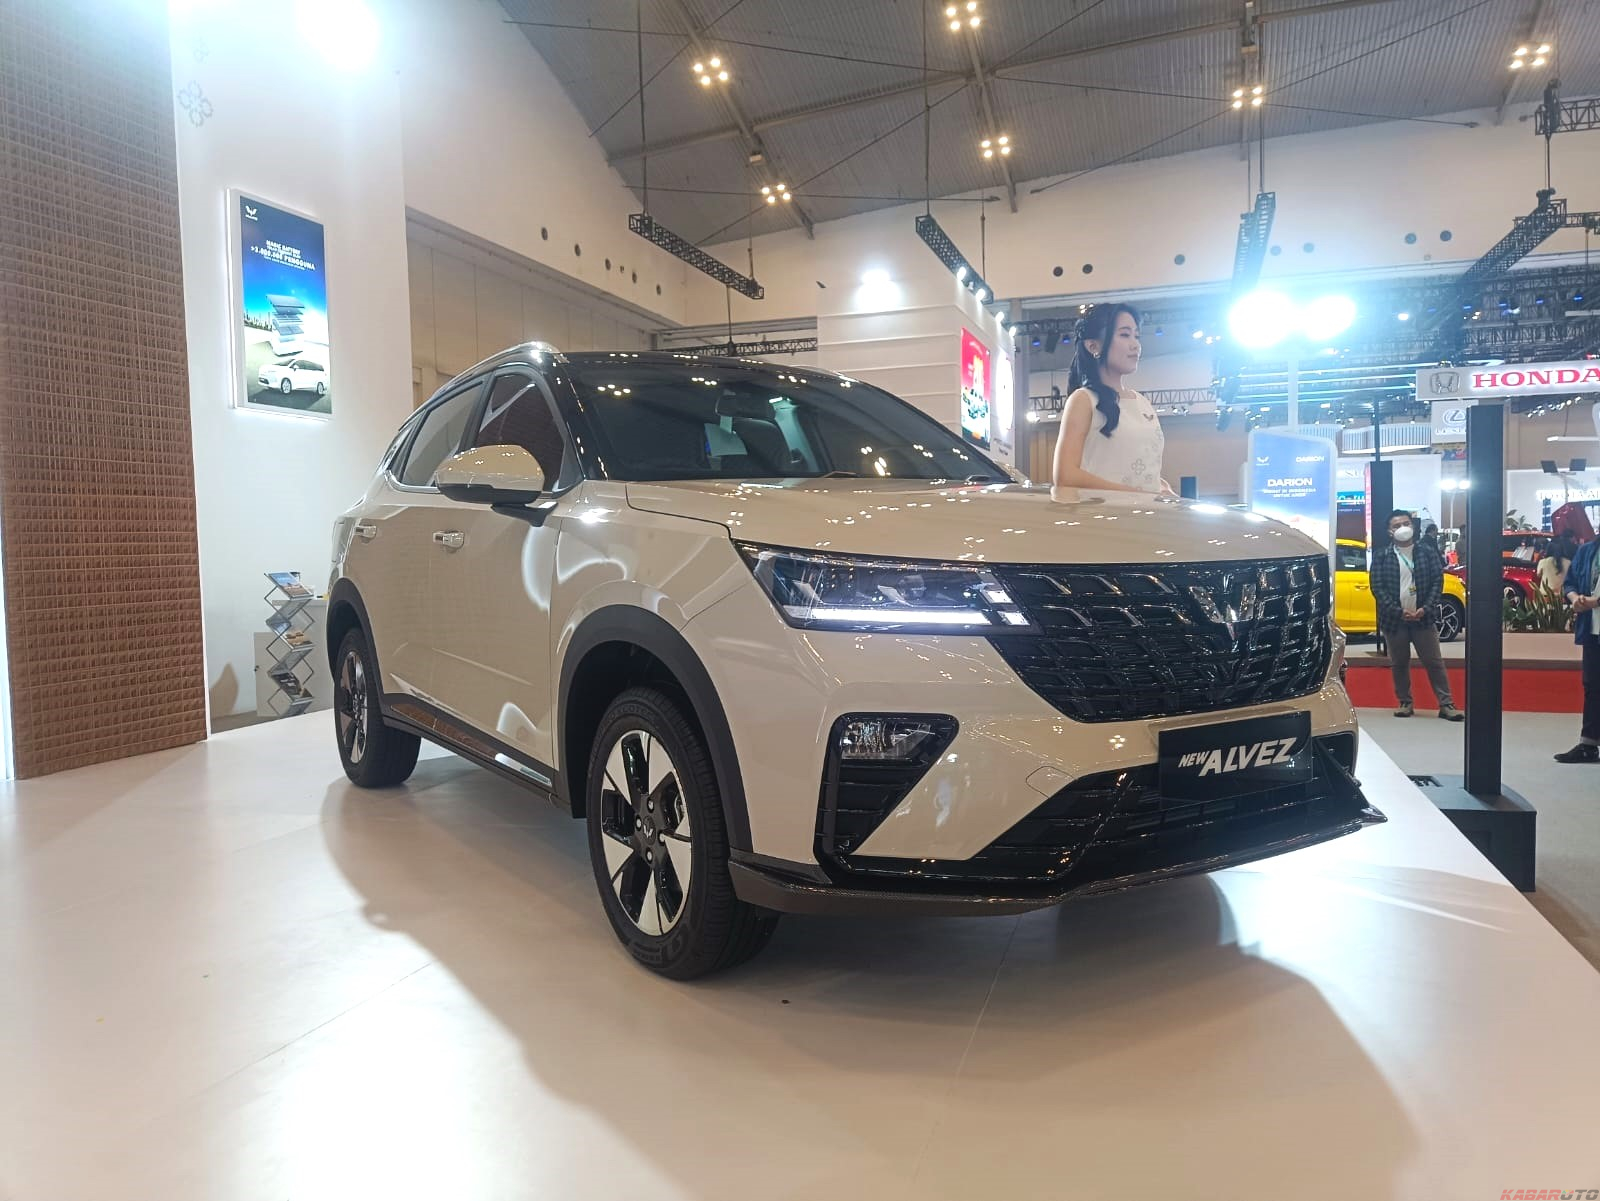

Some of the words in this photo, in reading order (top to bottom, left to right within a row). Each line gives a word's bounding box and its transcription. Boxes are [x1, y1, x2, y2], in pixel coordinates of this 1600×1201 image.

[1473, 368, 1600, 388] HONDA
[1267, 477, 1313, 487] DARION
[1178, 750, 1210, 768] NEW
[1198, 737, 1297, 777] ALVEZ
